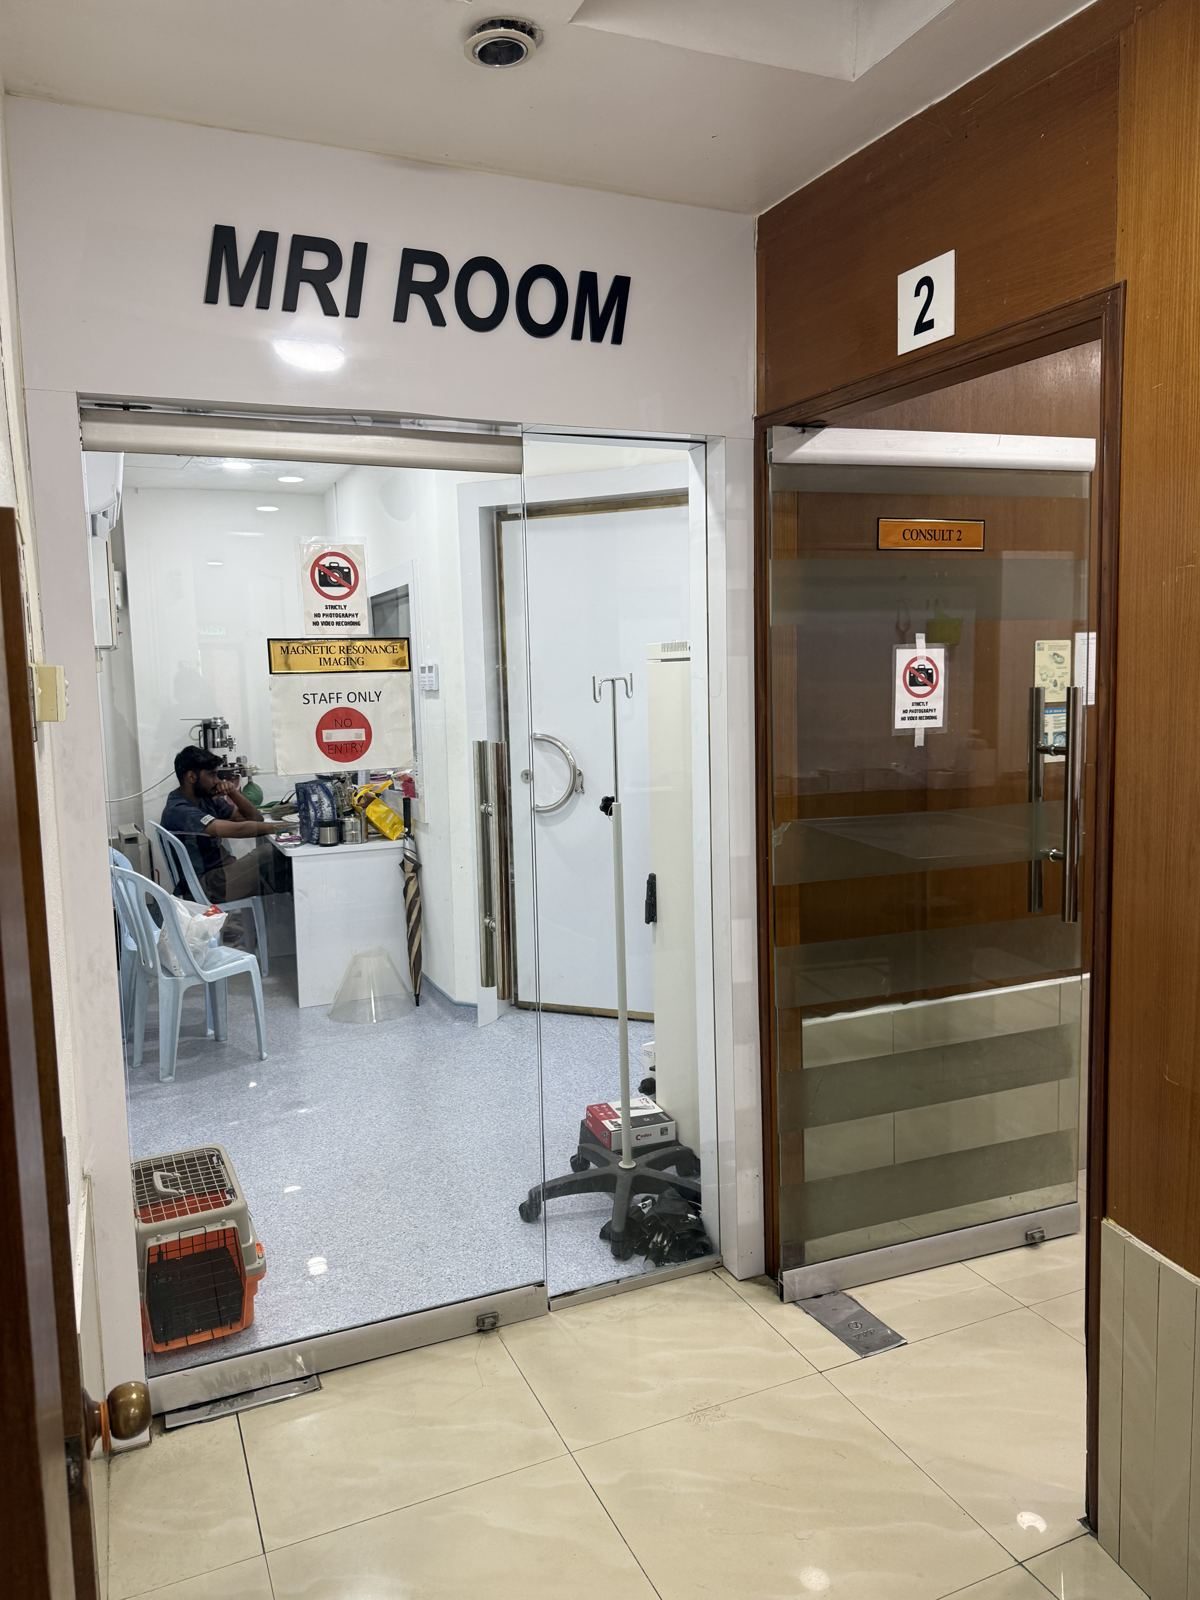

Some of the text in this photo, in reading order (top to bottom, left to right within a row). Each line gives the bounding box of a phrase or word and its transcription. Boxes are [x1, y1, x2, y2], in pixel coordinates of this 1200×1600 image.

[203, 223, 632, 346] MRI ROOM
[913, 275, 935, 337] 2
[902, 528, 963, 541] CONSULT 2
[280, 644, 399, 655] MAGNETIC RESONANCE
[319, 657, 365, 666] IMAGING
[302, 691, 382, 705] STAFF ONLY
[334, 718, 353, 728] NO
[327, 743, 364, 755] ENTRY
